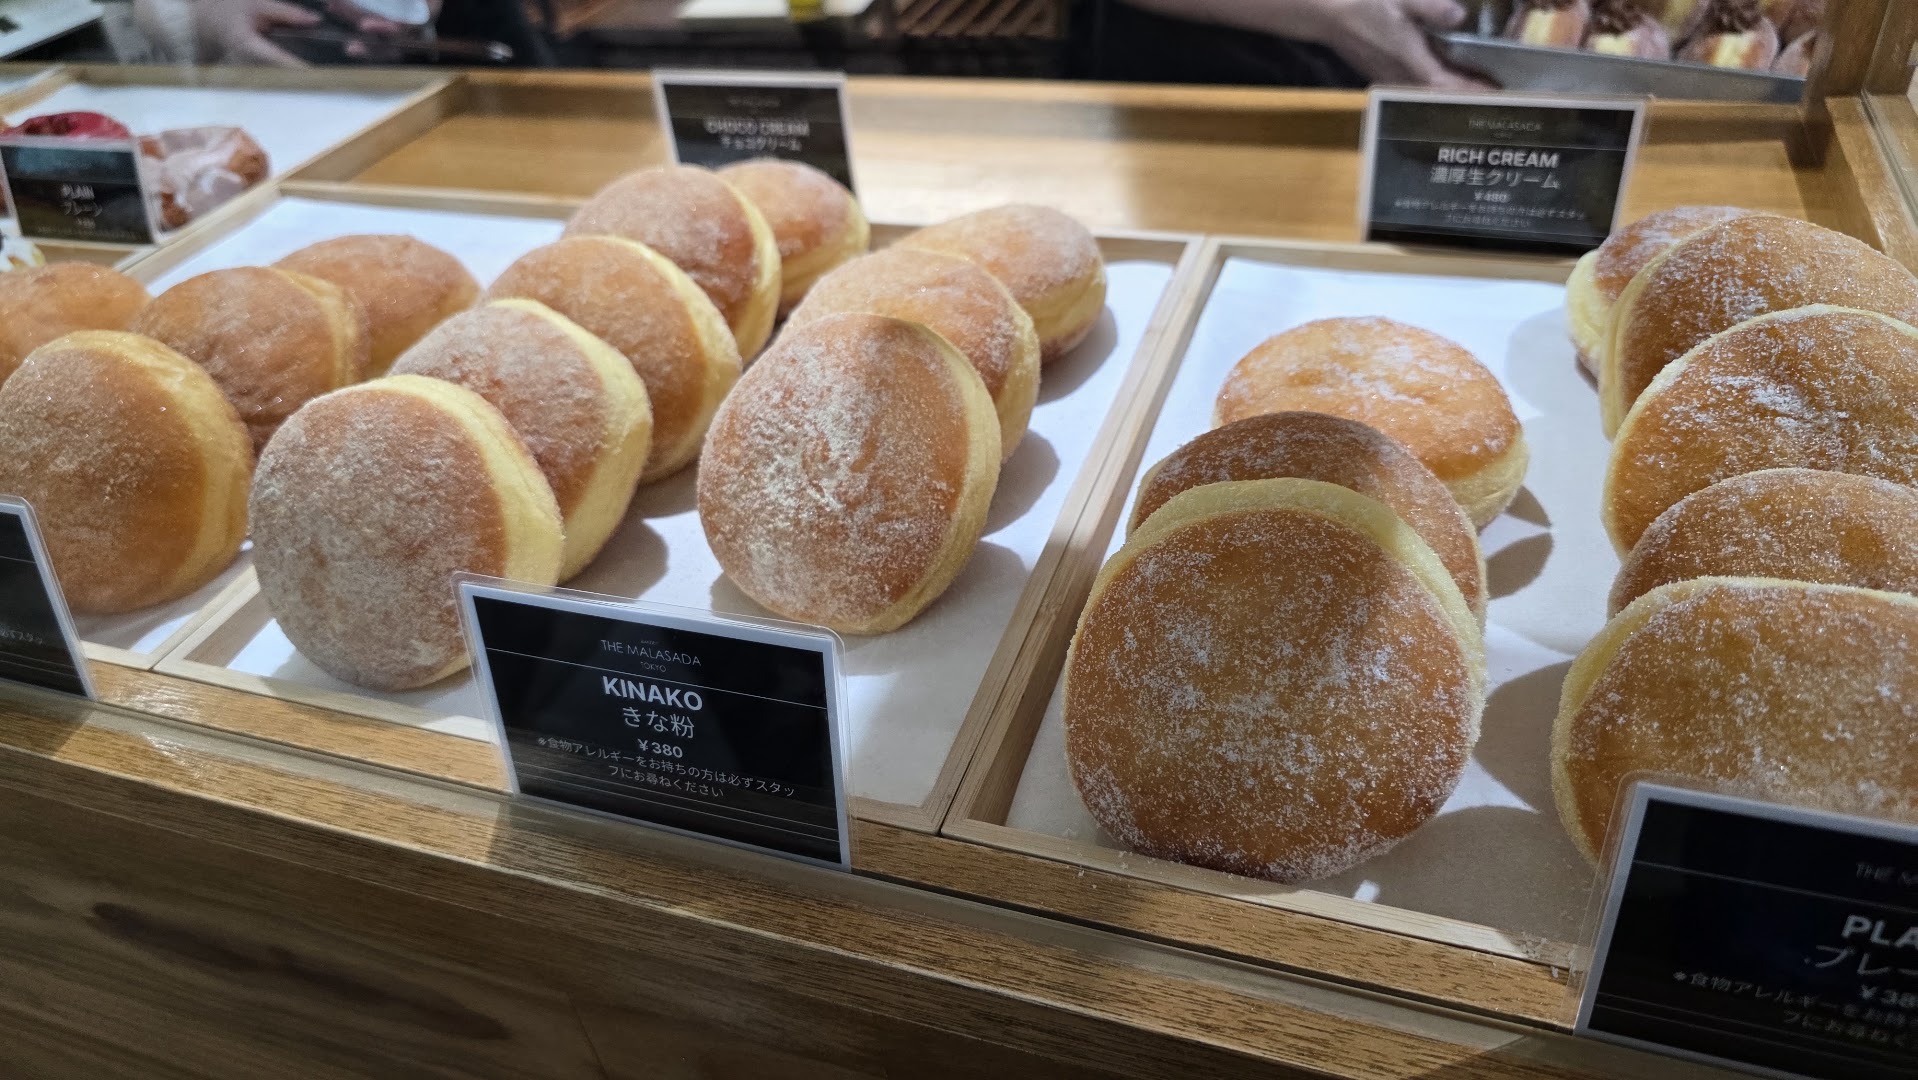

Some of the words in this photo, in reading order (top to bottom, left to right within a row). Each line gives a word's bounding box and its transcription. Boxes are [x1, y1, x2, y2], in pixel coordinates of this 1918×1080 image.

[1437, 147, 1485, 164] RICH
[1487, 148, 1560, 168] CREAM
[1429, 166, 1561, 190] 濃厚生クリーム
[600, 639, 625, 654] THE
[627, 644, 702, 667] MALASADA
[640, 661, 667, 673] TOKYO
[602, 675, 704, 711] KINAKO
[622, 706, 695, 739] きな粉
[608, 764, 725, 797] フにお尋ねください
